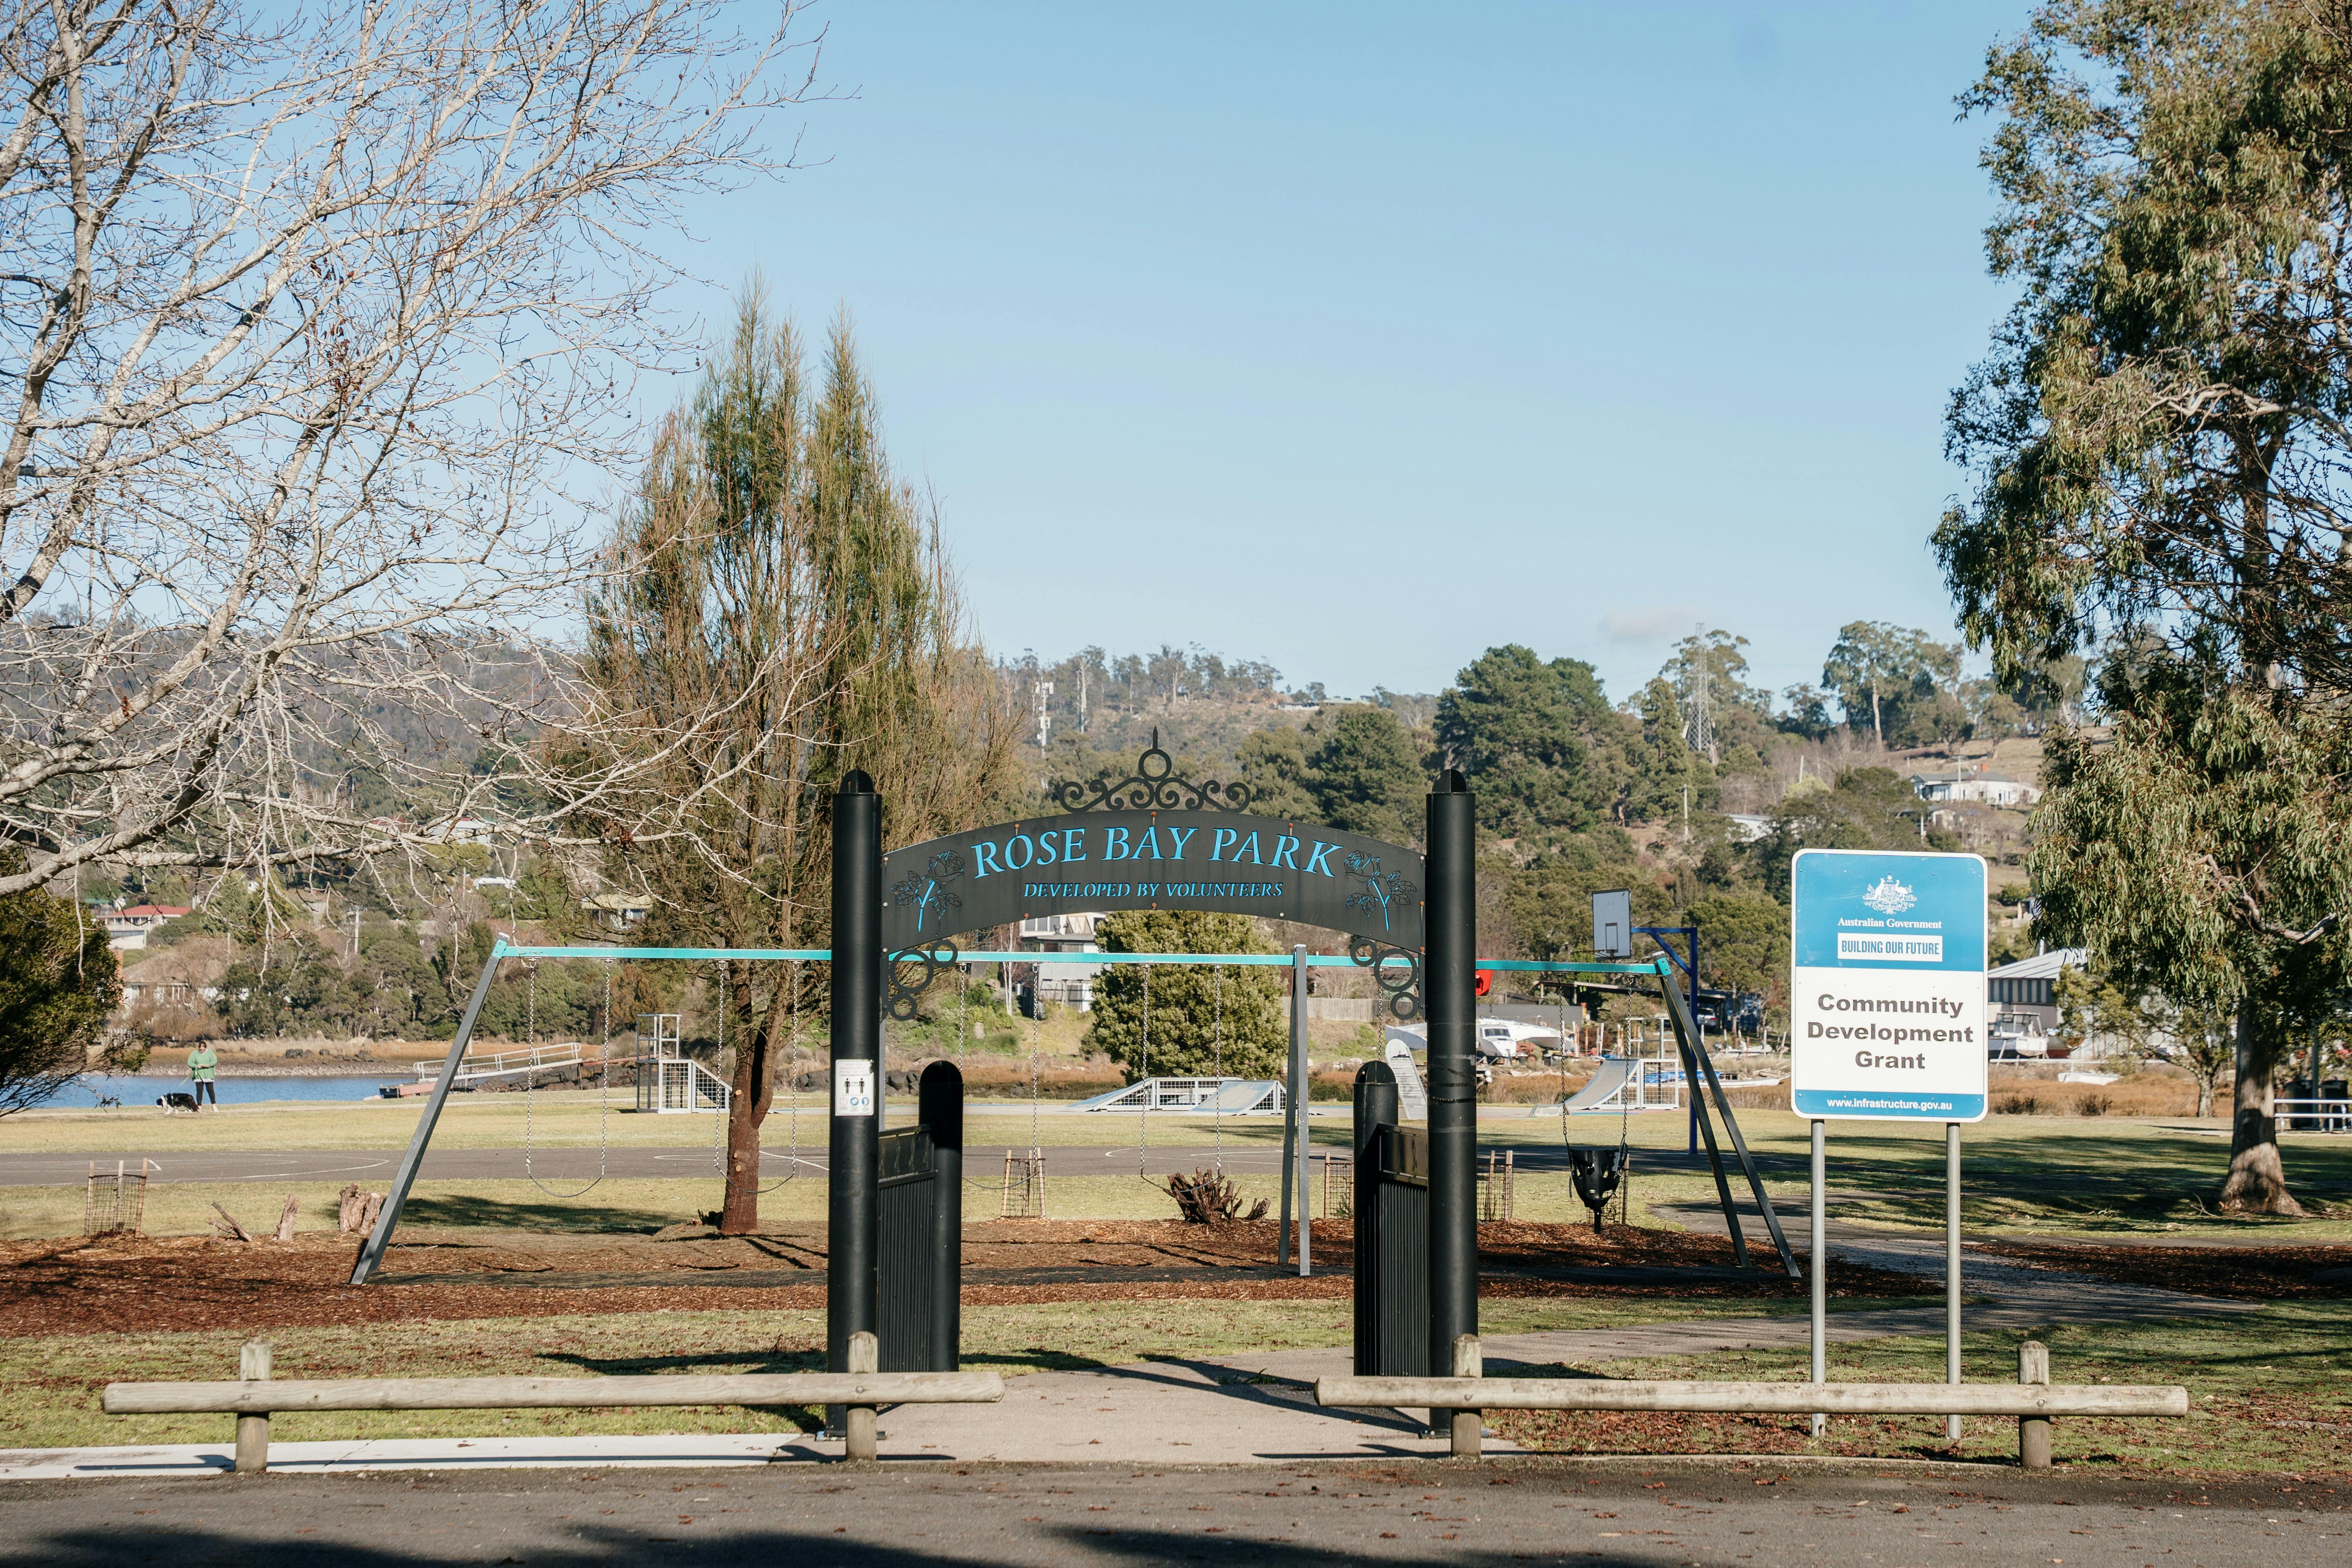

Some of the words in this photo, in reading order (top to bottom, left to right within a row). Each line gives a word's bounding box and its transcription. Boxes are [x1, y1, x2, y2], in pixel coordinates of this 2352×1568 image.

[971, 828, 1087, 879] ROSE
[1101, 826, 1200, 860] BAY
[1208, 828, 1343, 877] PARK
[1024, 883, 1130, 897] DEVELOPED
[1137, 883, 1160, 896] BY
[1166, 883, 1283, 897] VOLUNTEERS
[1837, 917, 1884, 927] Australian
[1886, 918, 1942, 929] Government
[1841, 940, 1883, 953] BUILDING
[1886, 942, 1903, 954] OUR
[1906, 942, 1939, 954] FUTURE
[1818, 994, 1963, 1018] Community
[1808, 1022, 1973, 1044] Development
[1855, 1051, 1925, 1069] Grant
[1827, 1098, 1952, 1111] www.infrastructure.gov.au
